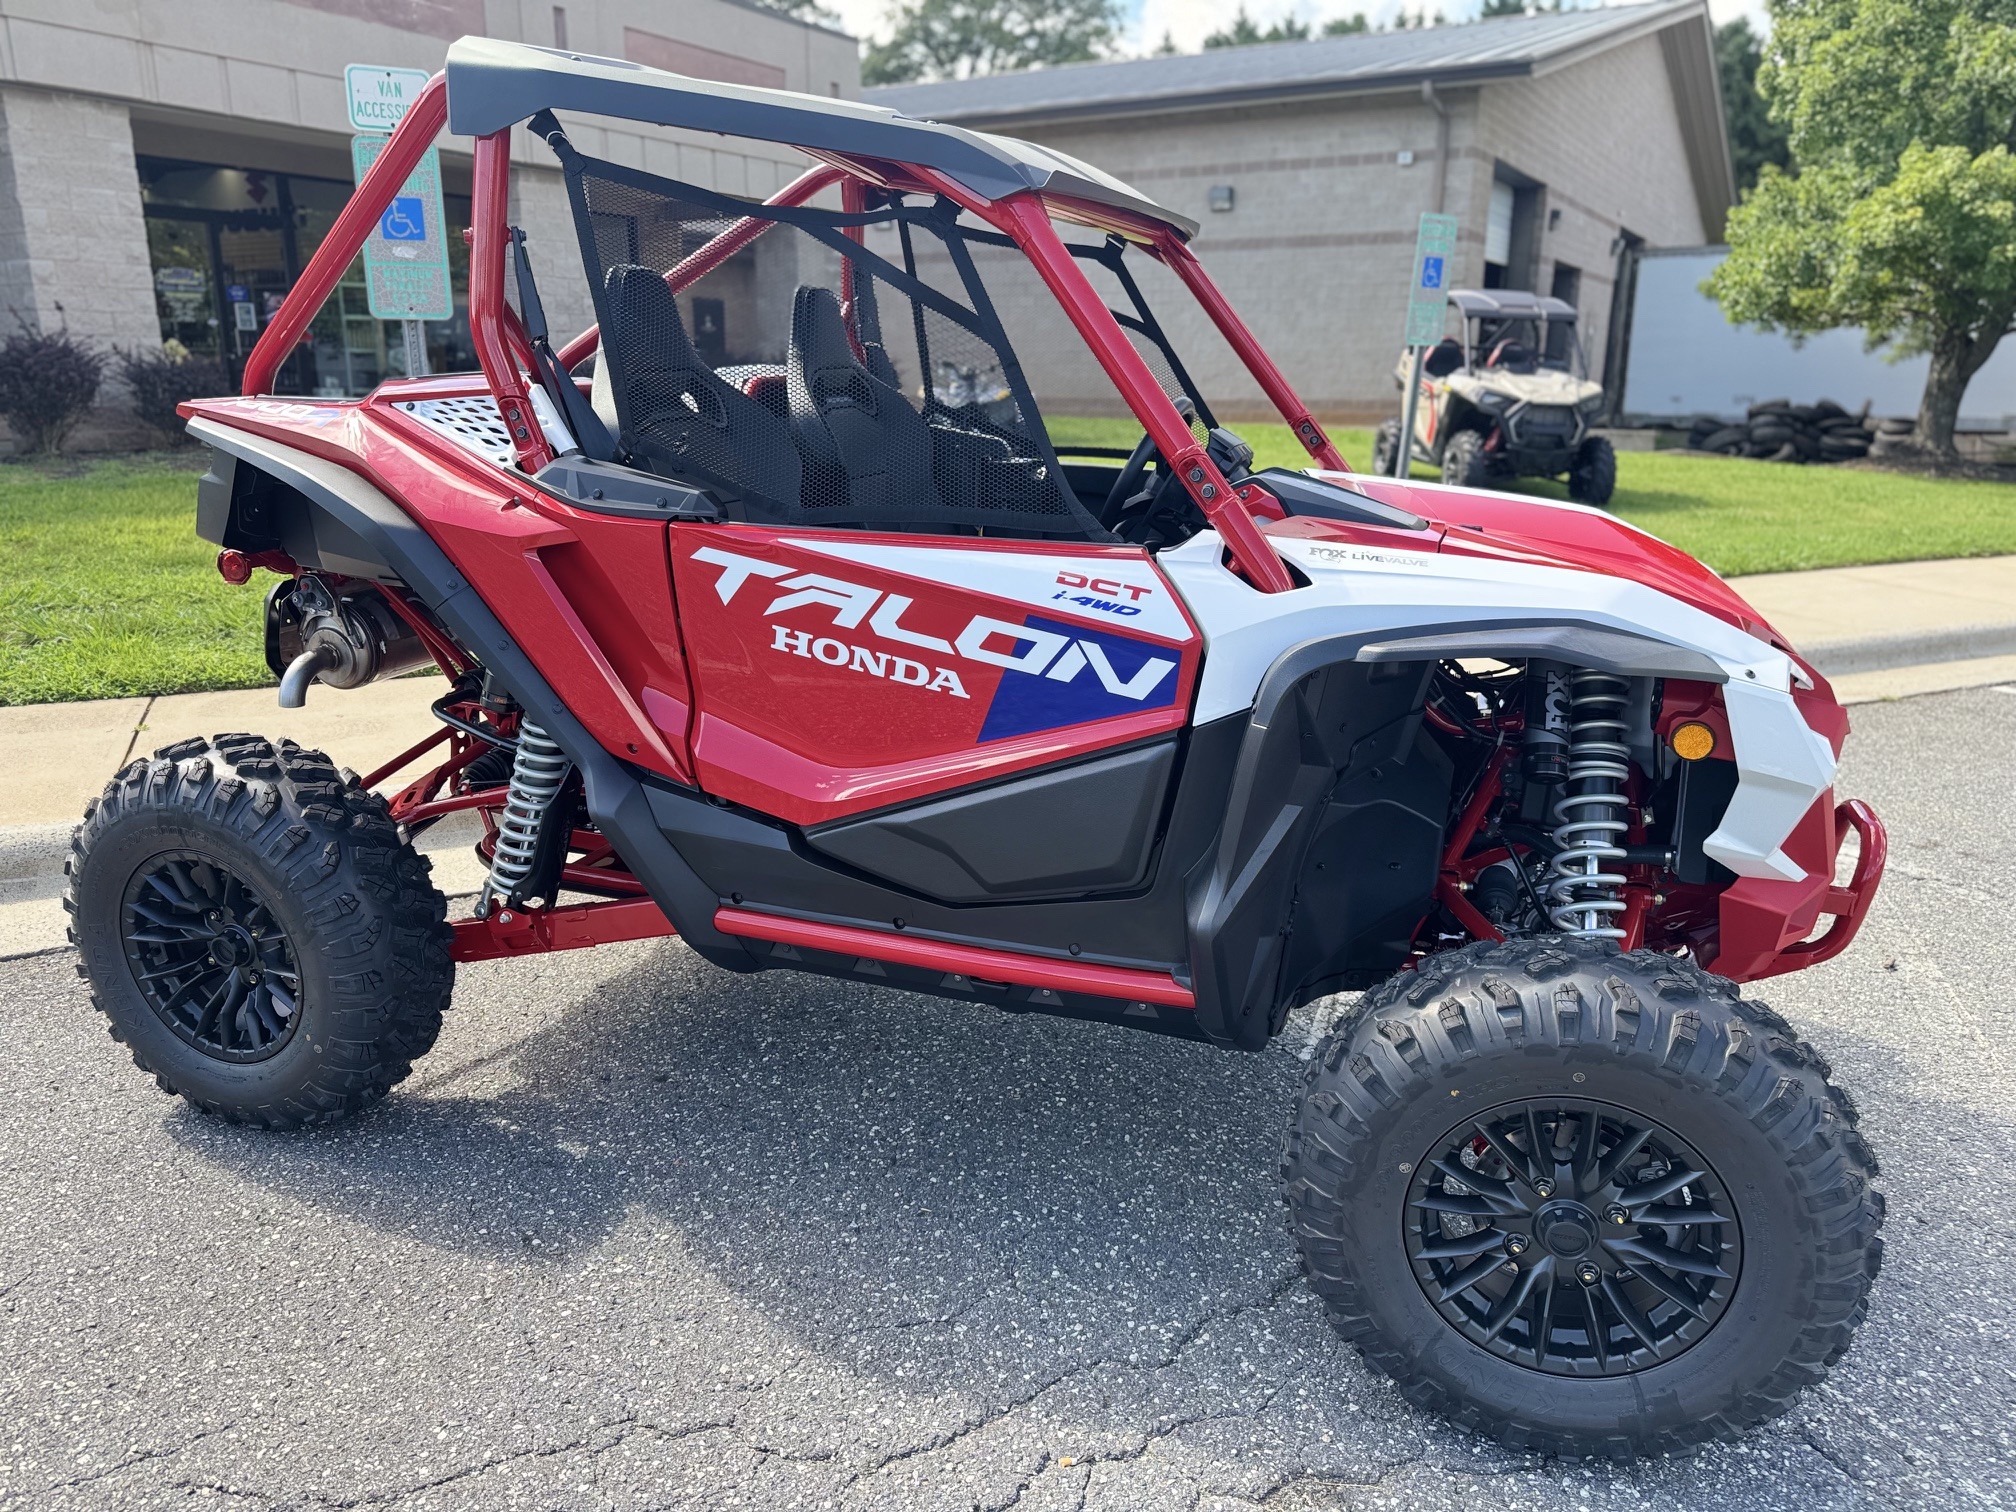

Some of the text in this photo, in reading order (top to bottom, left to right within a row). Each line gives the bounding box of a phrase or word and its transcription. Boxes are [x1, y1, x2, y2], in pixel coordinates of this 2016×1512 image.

[377, 80, 403, 98] VAN
[356, 101, 411, 120] ACCESSI
[1309, 547, 1347, 563] FOX
[1055, 570, 1153, 601] DCT
[1051, 590, 1142, 616] i-4WD
[690, 546, 1177, 701] TALON
[770, 624, 971, 699] HONDA
[1545, 671, 1571, 732] FOX
